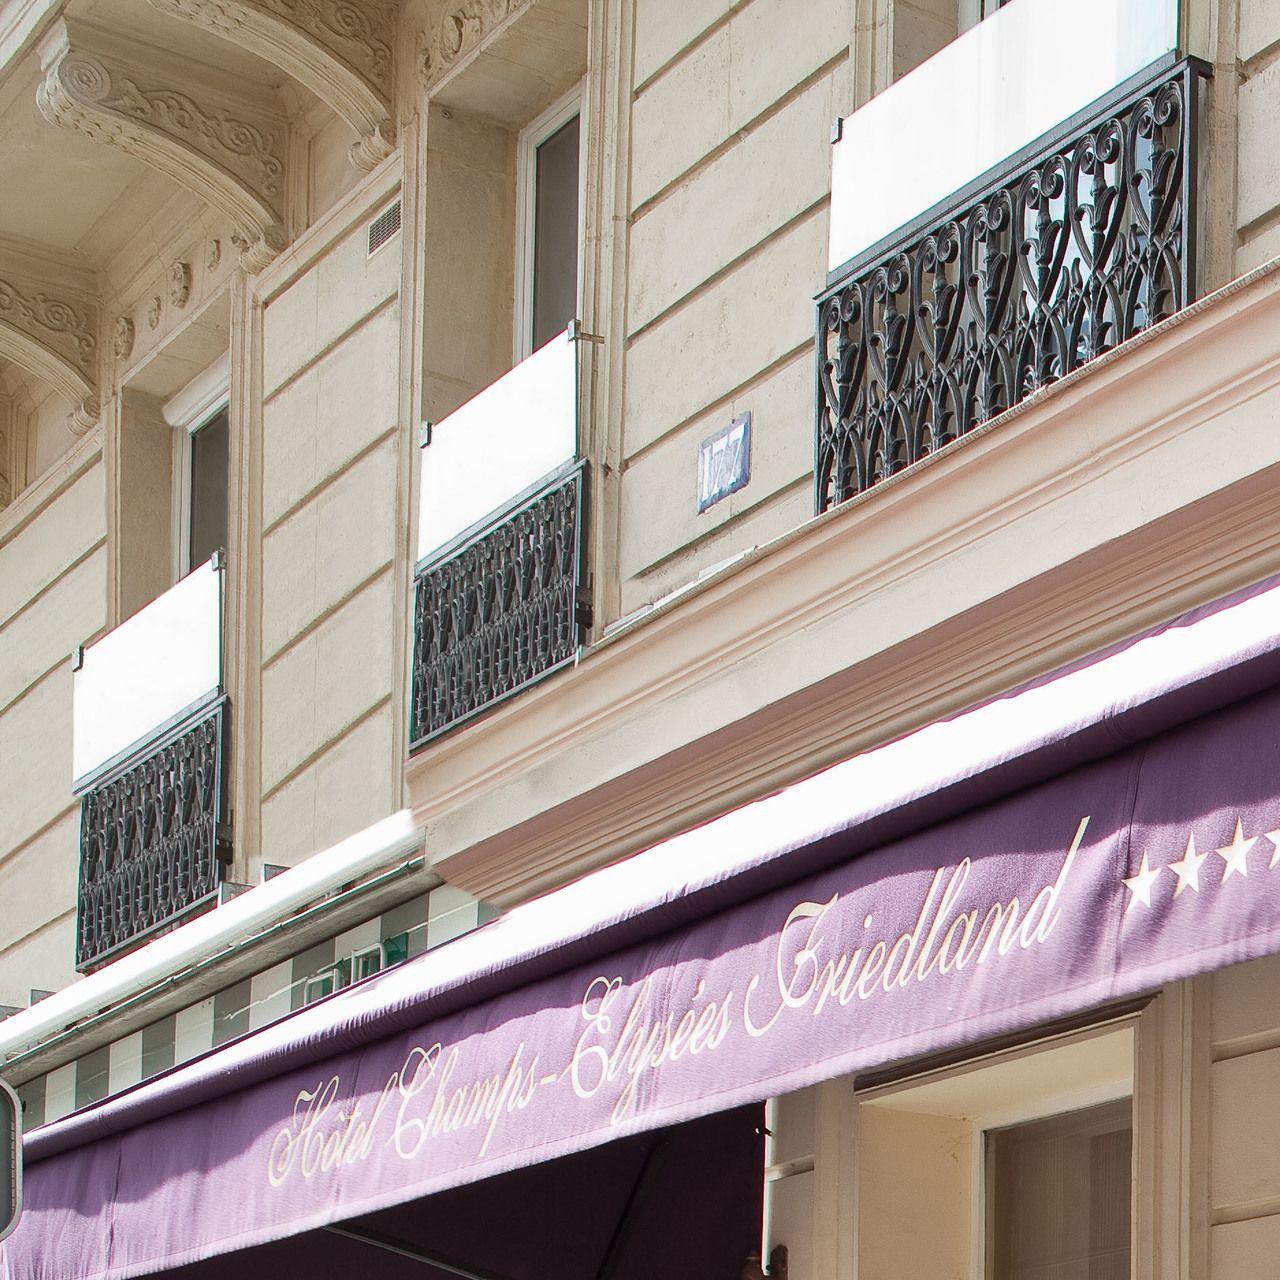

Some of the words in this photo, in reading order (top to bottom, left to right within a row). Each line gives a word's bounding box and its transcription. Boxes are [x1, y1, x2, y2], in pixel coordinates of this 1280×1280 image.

[702, 423, 745, 502] 177
[268, 1072, 398, 1187] Hôtel
[744, 816, 1091, 1037] Friedland
